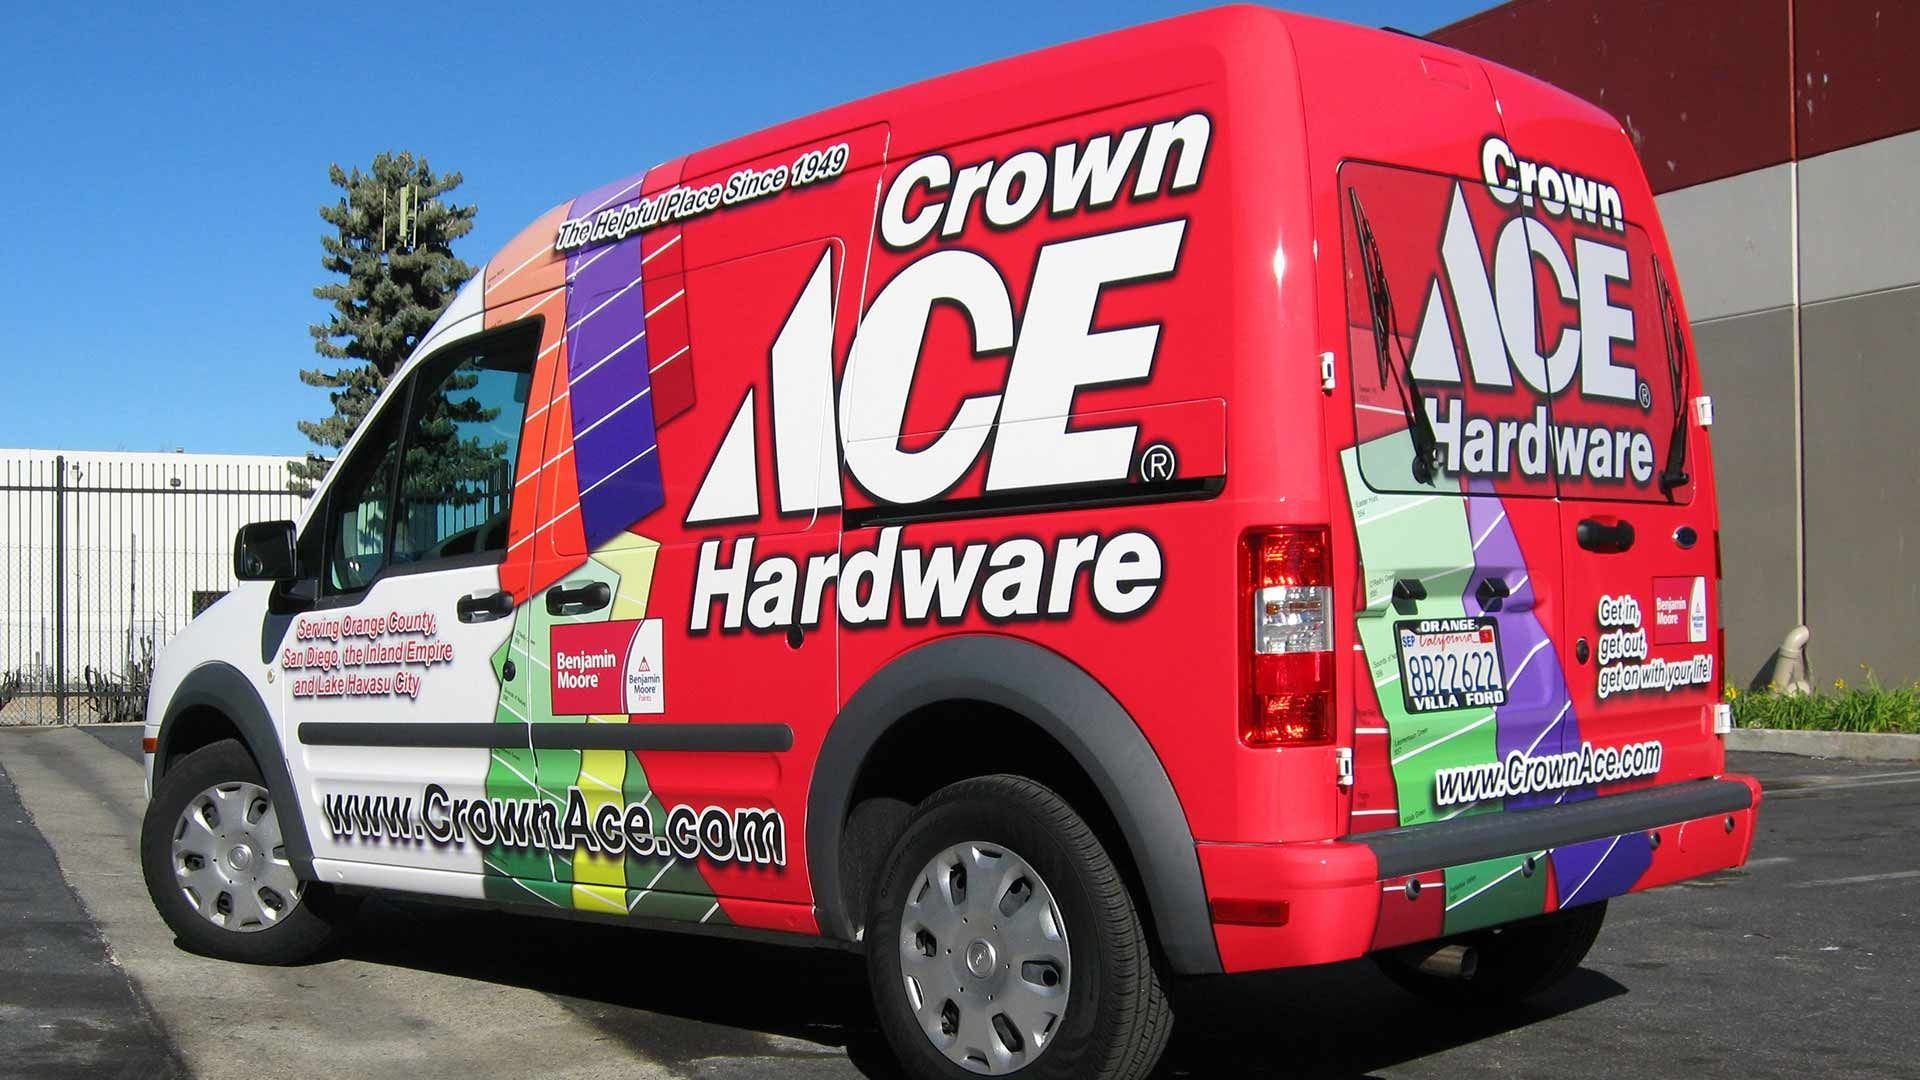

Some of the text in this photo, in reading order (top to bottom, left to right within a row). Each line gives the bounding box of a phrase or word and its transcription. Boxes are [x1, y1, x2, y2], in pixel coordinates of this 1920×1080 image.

[880, 111, 1211, 247] Crown
[1482, 137, 1624, 231] Crown
[558, 146, 847, 249] The Helpful Place Since 1949
[1410, 181, 1636, 400] ACE
[685, 219, 1189, 525] ACE
[1425, 397, 1655, 482] Hardware
[690, 526, 1162, 630] Hardware
[1600, 598, 1622, 623] Get
[1656, 597, 1686, 613] Benjamin
[1656, 612, 1679, 625] Moore
[298, 611, 436, 641] Serving Orange County,
[1421, 619, 1476, 632] ORANGE
[284, 640, 453, 671] San Diego, the Inland Empire
[1419, 633, 1475, 651] California
[1600, 632, 1646, 661] get out,
[557, 649, 616, 672] Benjamin
[1409, 651, 1498, 696] 8B22622
[1600, 656, 1712, 694] get on with your life!
[295, 672, 420, 698] and Lake Havasu City
[557, 671, 599, 689] Moore
[629, 674, 660, 686] Benjamin
[634, 685, 656, 693] Moore
[1414, 690, 1505, 710] VILLA FORD
[1437, 742, 1661, 803] www.CrownAce.com
[325, 783, 787, 866] www.CrownAce.com
